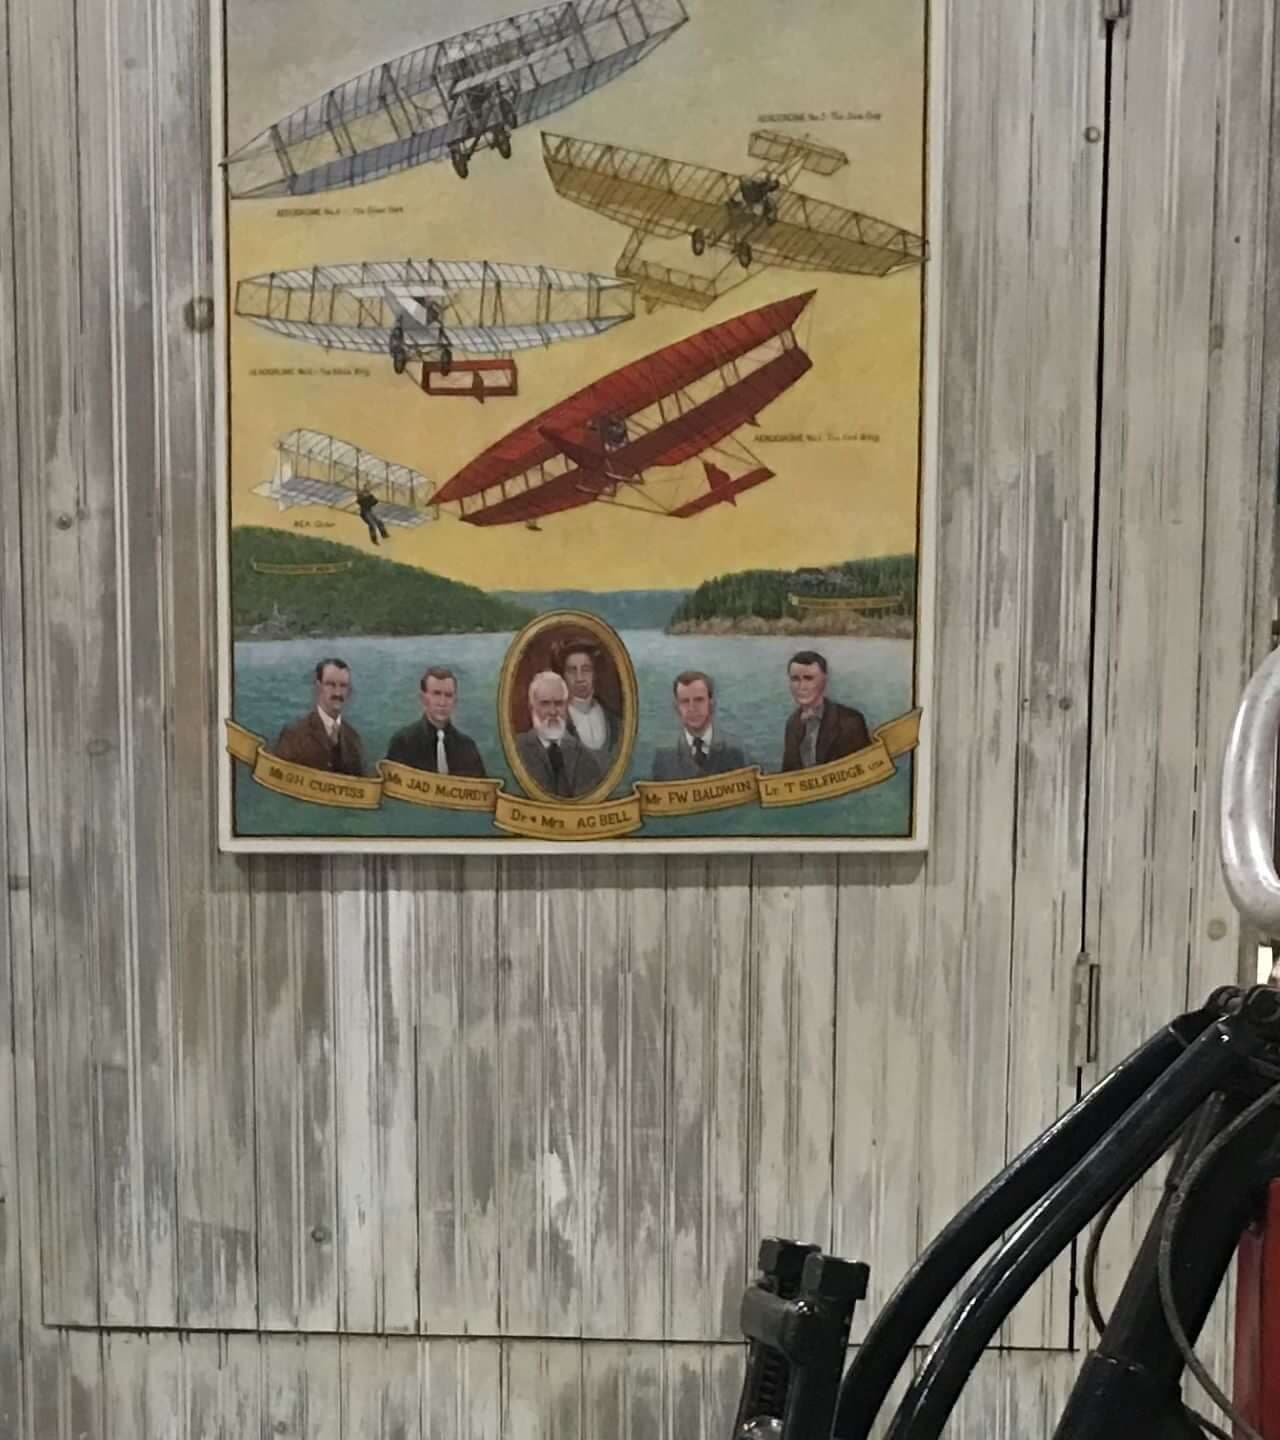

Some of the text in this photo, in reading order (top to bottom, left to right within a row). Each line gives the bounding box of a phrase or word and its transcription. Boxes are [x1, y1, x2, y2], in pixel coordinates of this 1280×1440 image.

[799, 763, 865, 791] SELFRIDGE
[310, 780, 365, 799] CURTISS
[693, 780, 751, 802] BALDWIN
[599, 809, 632, 826] BELL
